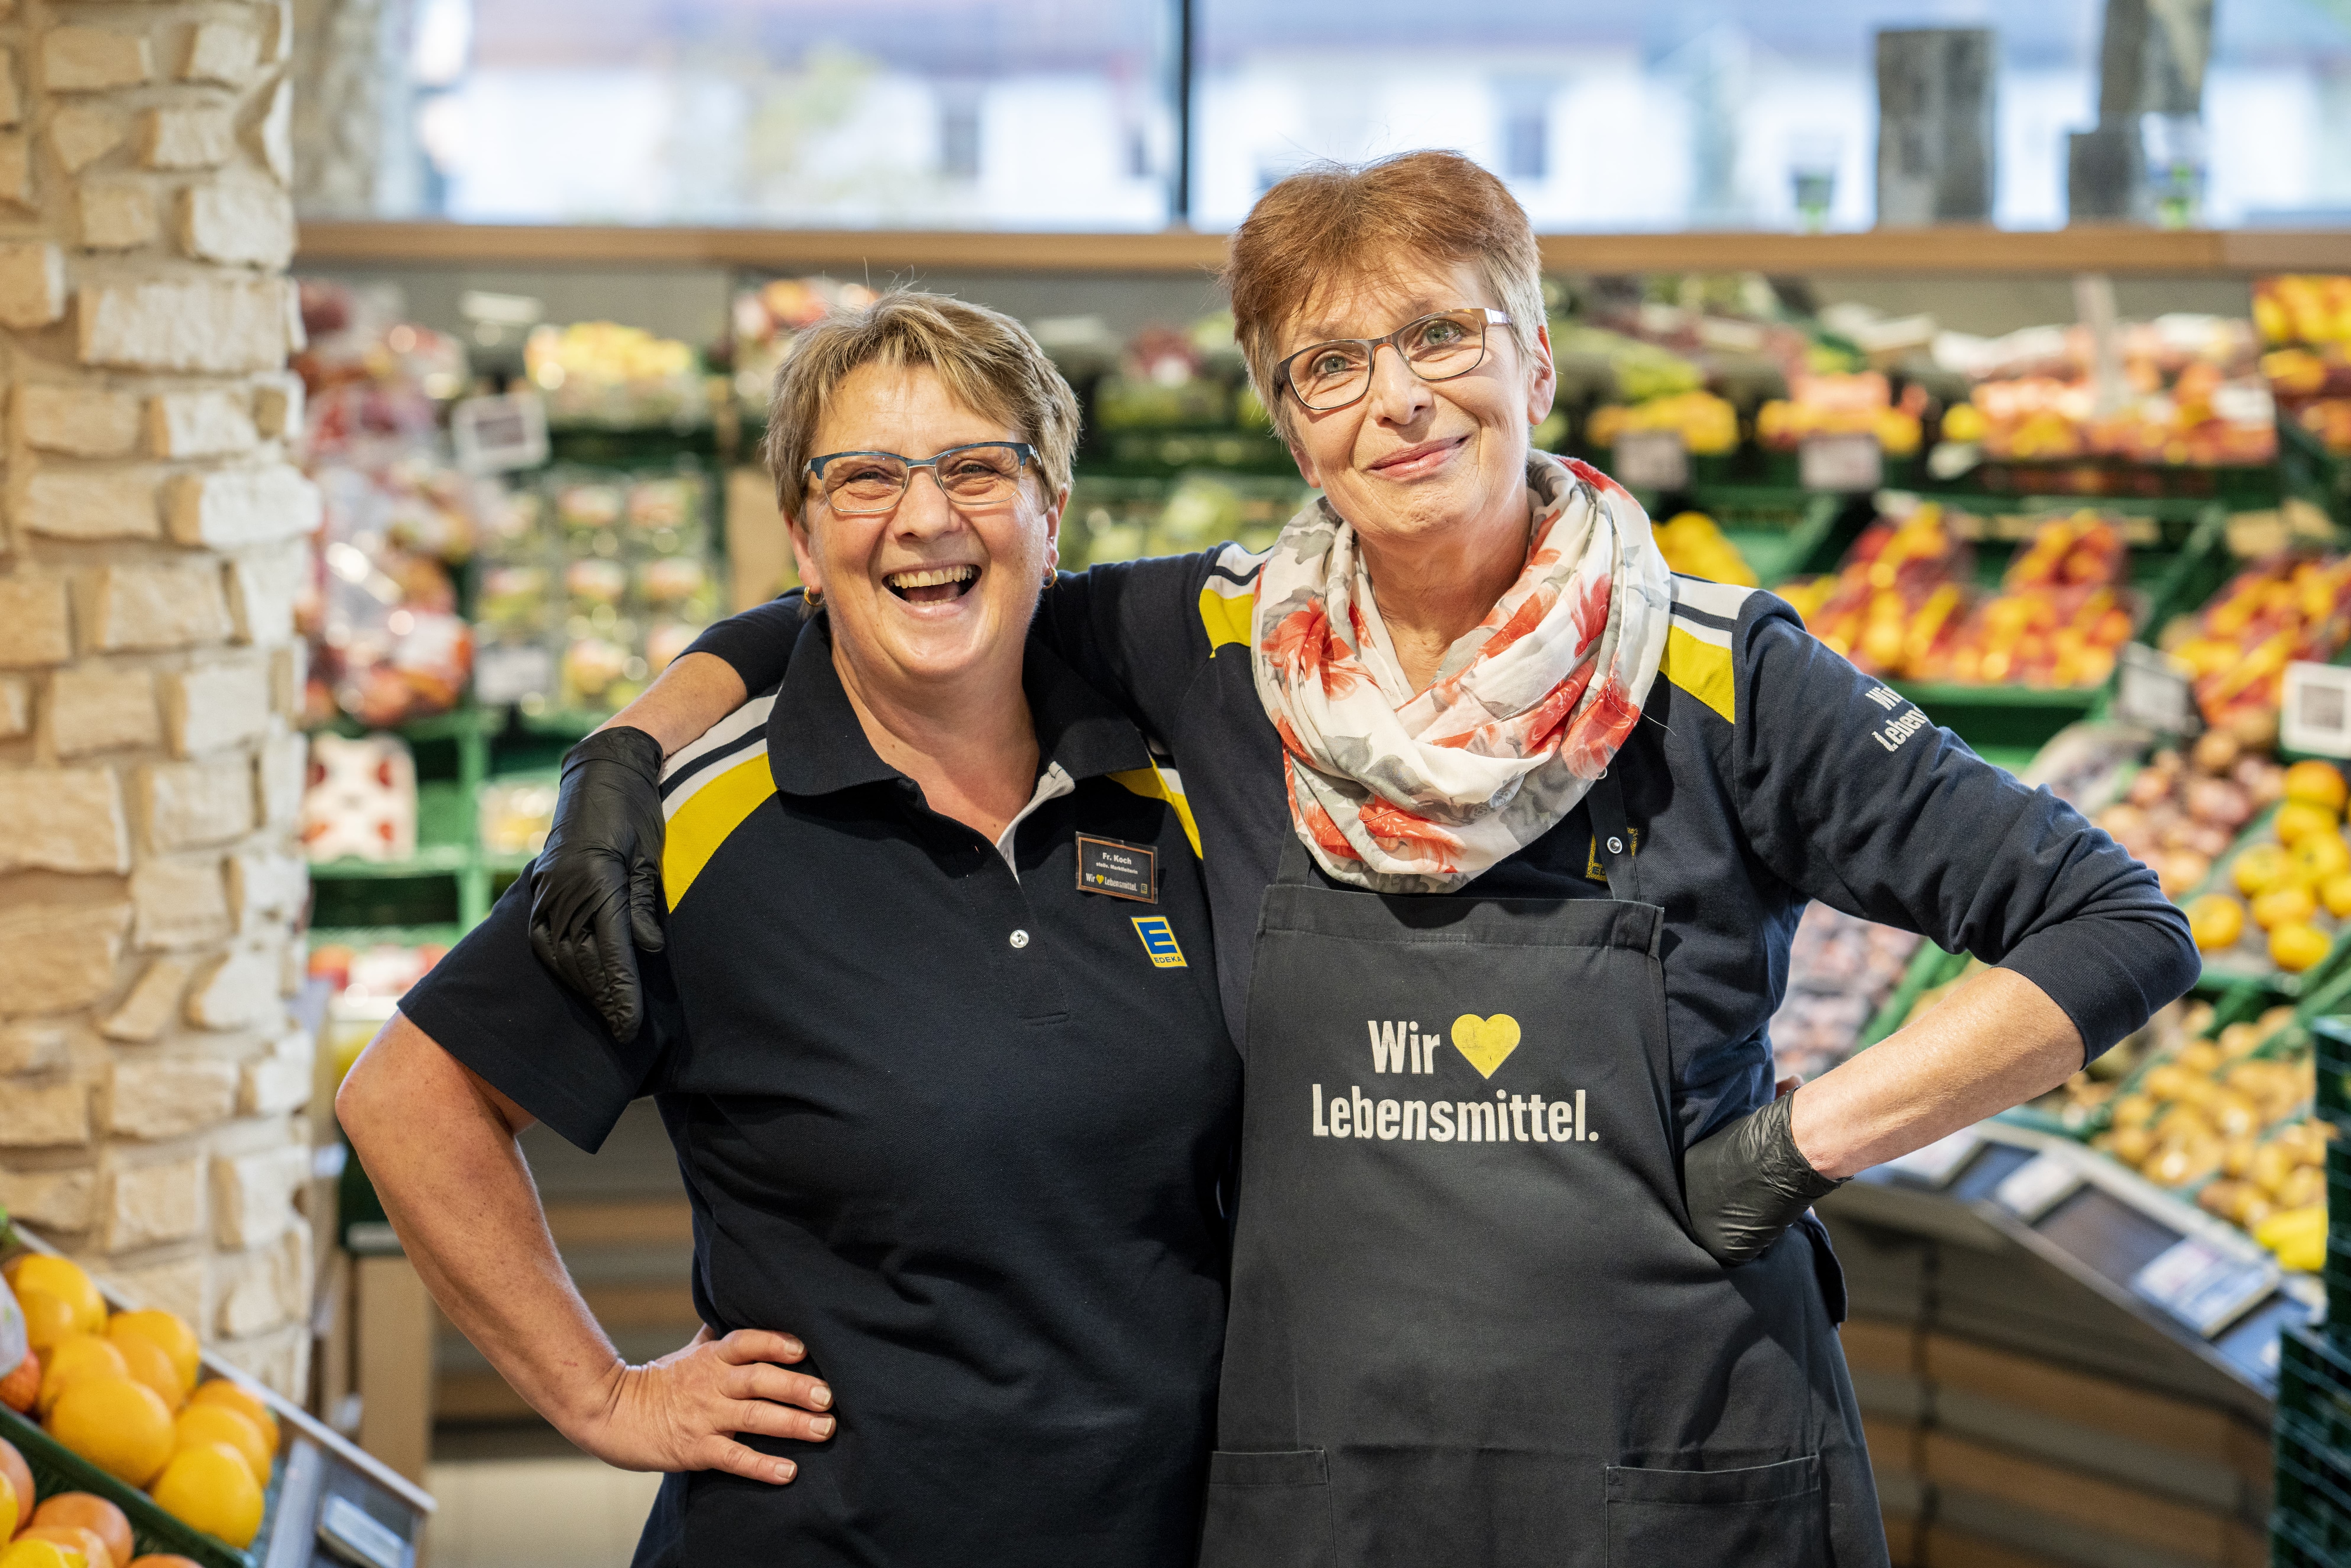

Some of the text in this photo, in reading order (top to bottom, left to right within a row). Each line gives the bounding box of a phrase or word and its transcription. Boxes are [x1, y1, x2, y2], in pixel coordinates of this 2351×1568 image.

[1865, 686, 1904, 711] Wir
[1102, 852, 1132, 865] Fr. Koch
[1086, 873, 1137, 891] Wir Lebensmittel.
[1368, 1020, 1440, 1074] Wir
[1312, 1083, 1599, 1143] Lebensmittel.
